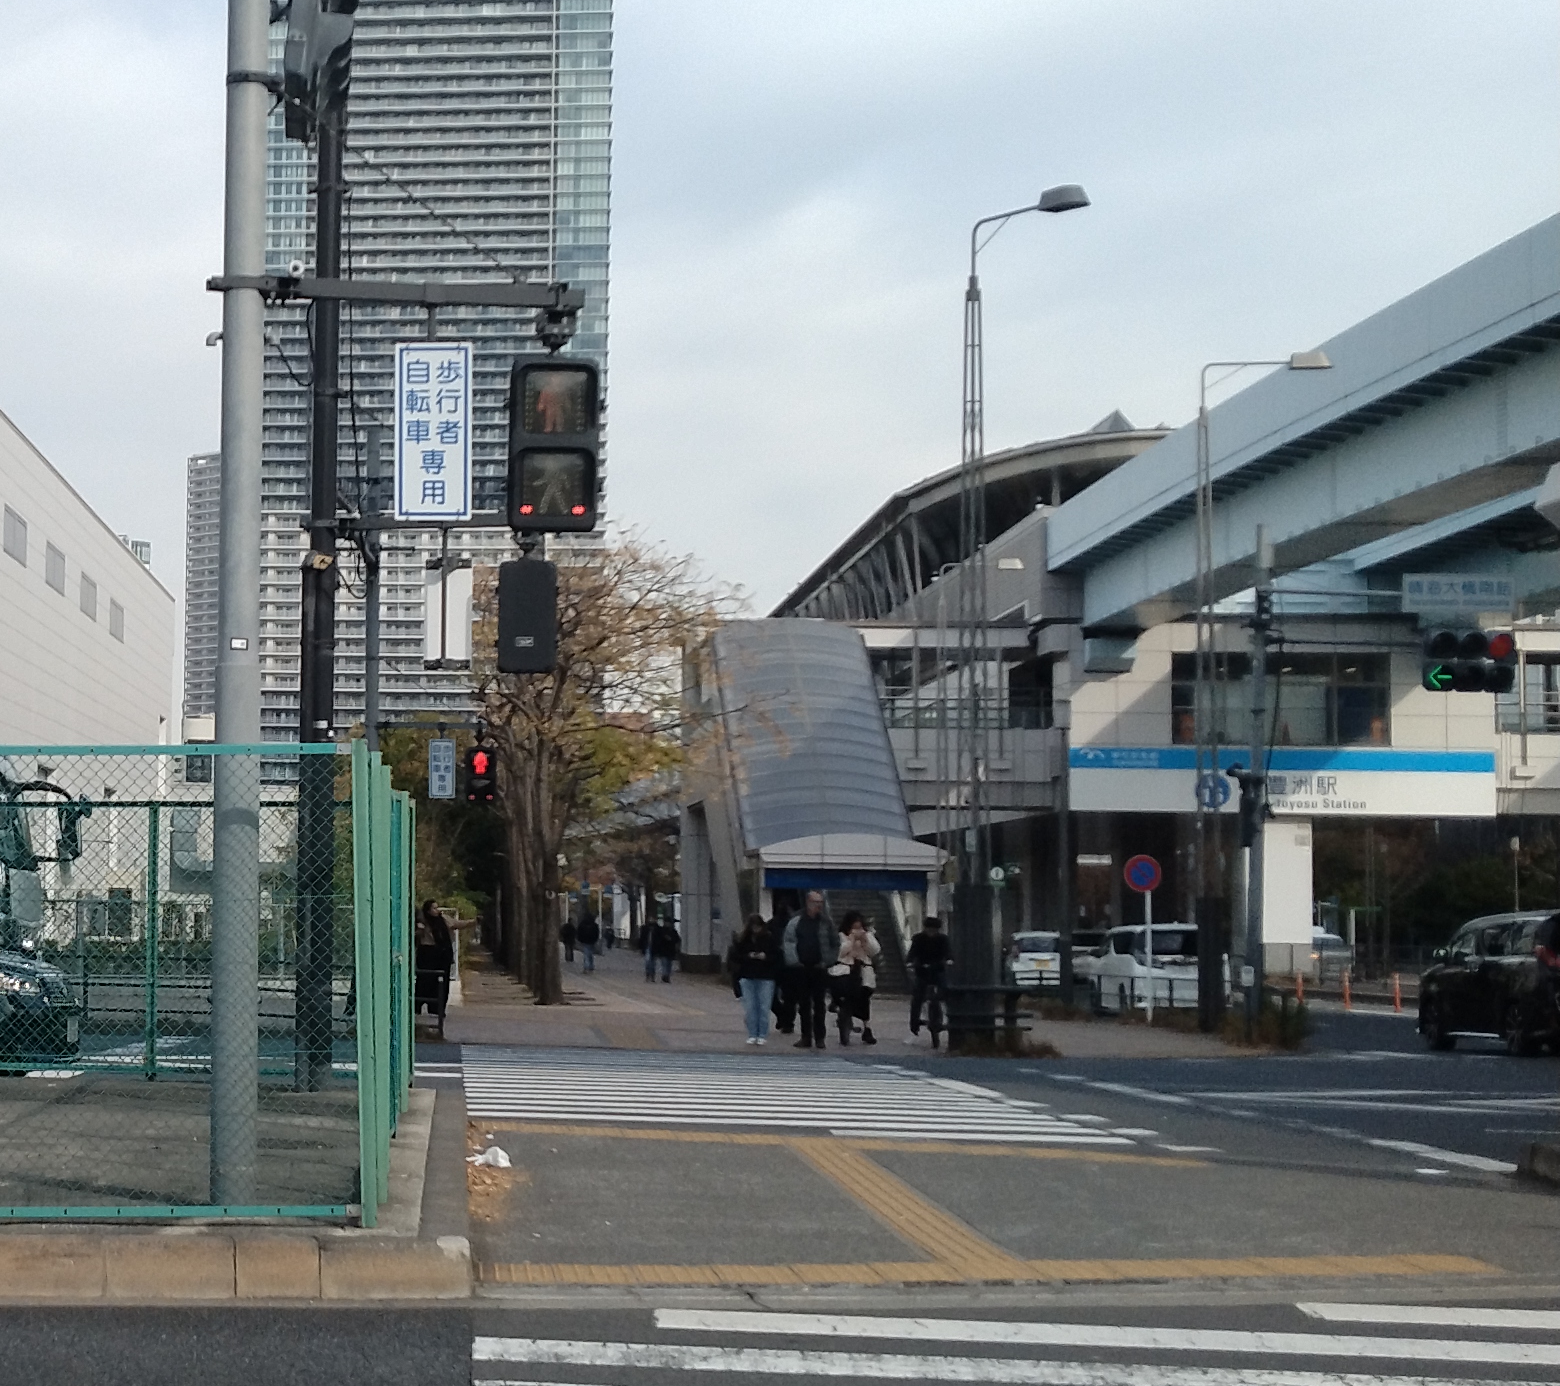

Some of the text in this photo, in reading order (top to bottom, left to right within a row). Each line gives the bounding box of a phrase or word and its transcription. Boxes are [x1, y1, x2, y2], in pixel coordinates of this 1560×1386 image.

[405, 359, 431, 445] 自転車
[436, 359, 463, 445] 歩行者
[420, 449, 446, 505] 専用
[1323, 798, 1367, 809] Station
